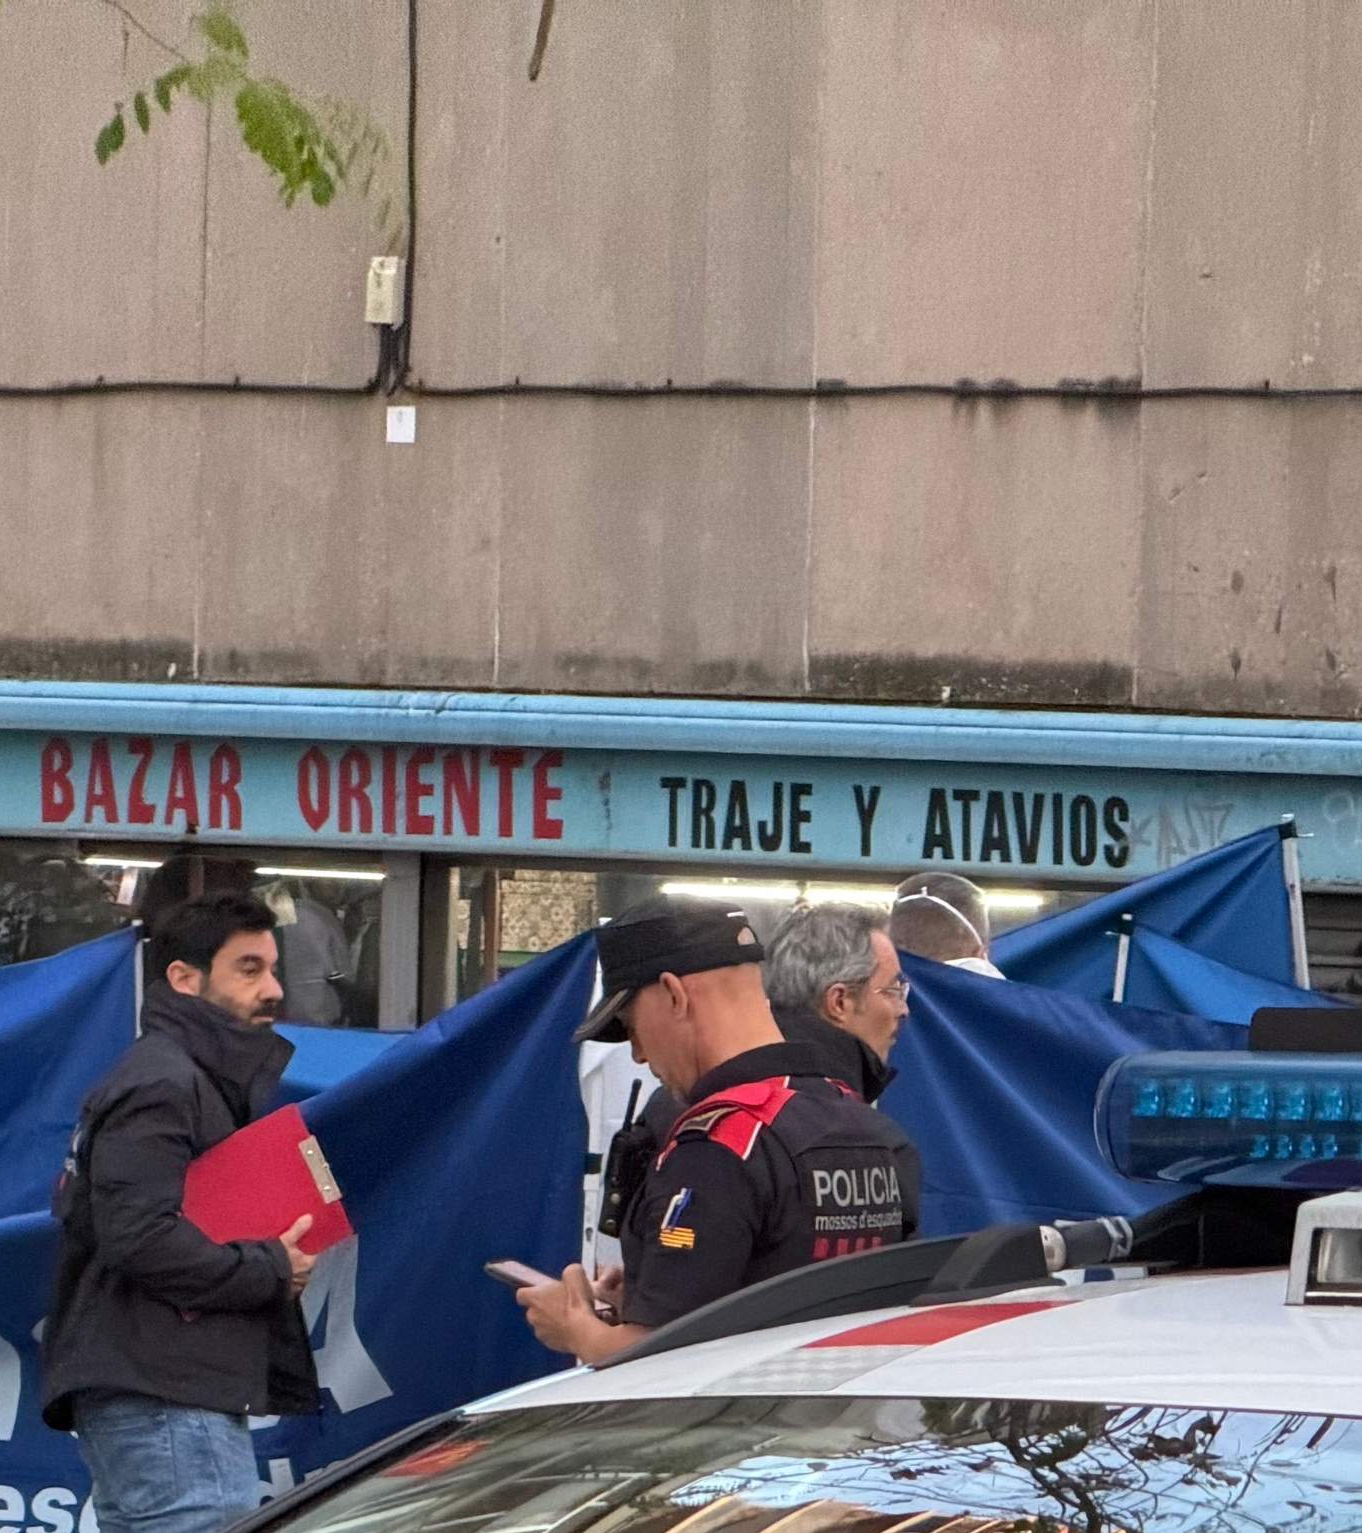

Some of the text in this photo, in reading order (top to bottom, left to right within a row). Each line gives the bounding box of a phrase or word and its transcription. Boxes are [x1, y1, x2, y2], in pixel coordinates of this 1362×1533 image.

[41, 736, 564, 840] BAZAR ORIENTE
[660, 777, 813, 854] TRAJE
[853, 785, 881, 858] Y
[921, 788, 1131, 869] ATAVIOS
[813, 1166, 902, 1207] POLICIA
[815, 1215, 857, 1231] mossos
